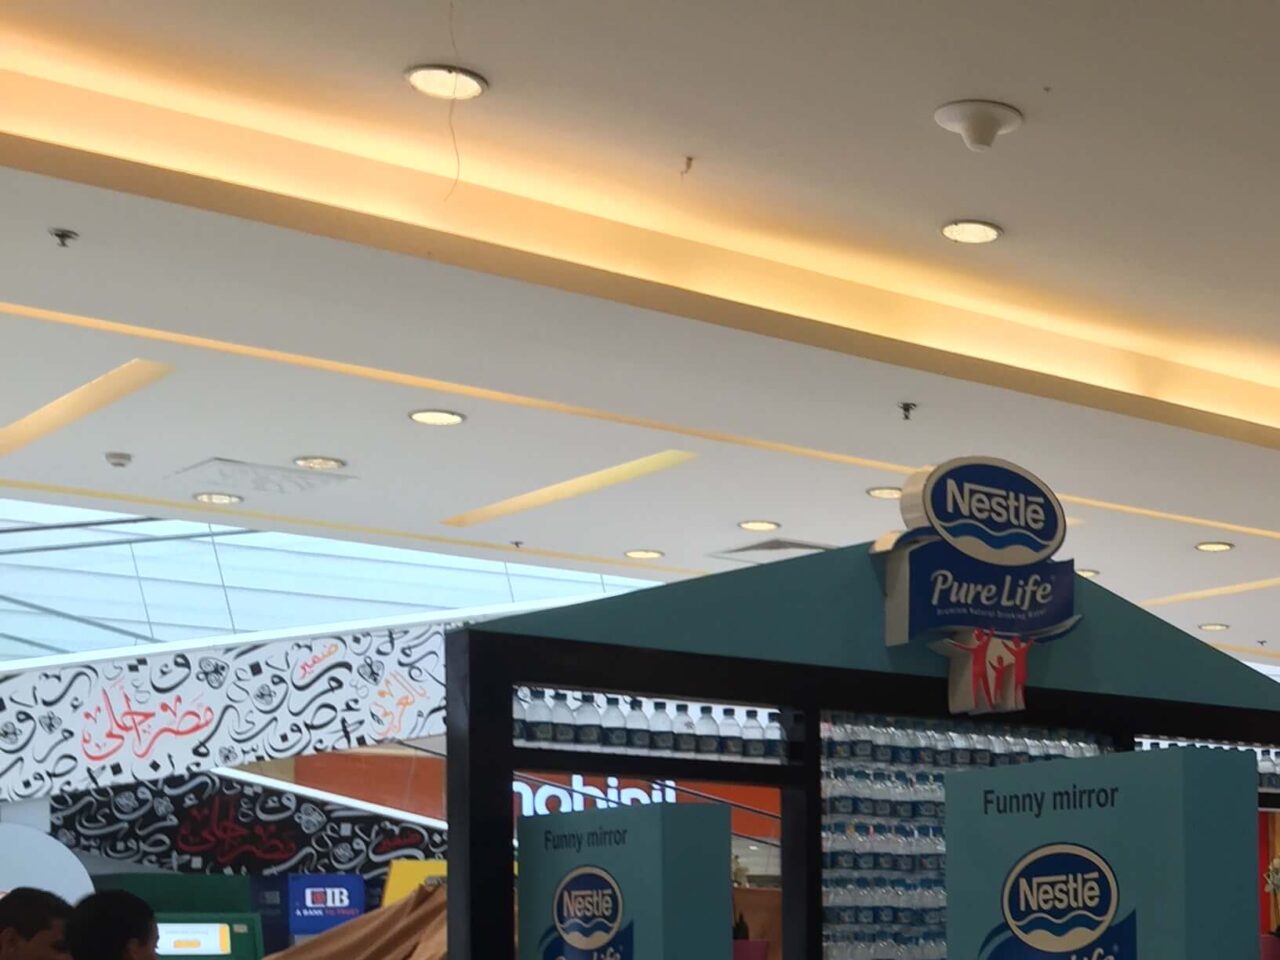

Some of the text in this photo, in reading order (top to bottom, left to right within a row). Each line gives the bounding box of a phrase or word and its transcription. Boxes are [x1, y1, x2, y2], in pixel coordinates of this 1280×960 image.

[945, 477, 1046, 531] Nestlé
[930, 569, 1053, 611] Pure Life
[983, 784, 1119, 819] Funny mirror
[544, 827, 628, 853] Funny mirror
[1018, 871, 1101, 912] Nestlé
